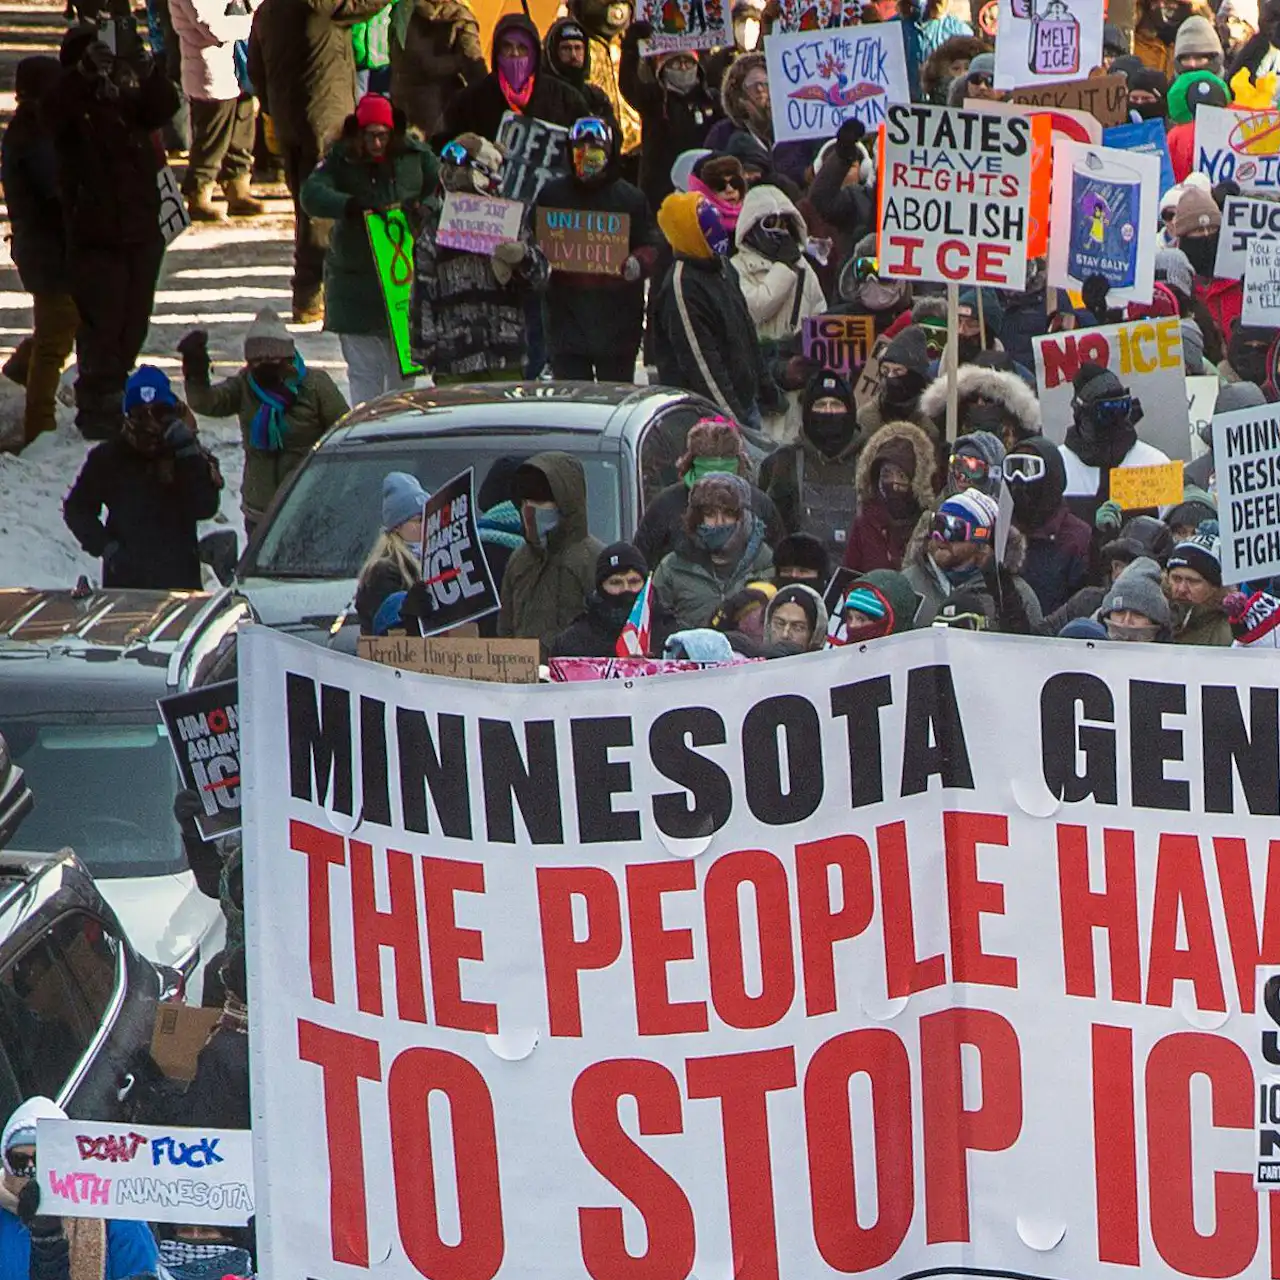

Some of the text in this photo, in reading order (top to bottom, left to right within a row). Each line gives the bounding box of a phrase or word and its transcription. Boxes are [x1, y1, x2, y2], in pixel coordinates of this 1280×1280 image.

[1041, 25, 1076, 49] MELT
[781, 40, 825, 85] GET
[831, 35, 853, 60] THE
[854, 36, 889, 86] FUCK
[1041, 47, 1076, 70] ICE!
[787, 95, 889, 131] OUT MN
[887, 105, 1030, 156] STATES
[892, 162, 1020, 199] RIGHTS
[910, 149, 1004, 174] HAVE
[1199, 146, 1237, 185] NO
[882, 197, 1025, 242] ABOLISH
[888, 236, 1012, 285] ICE
[1075, 253, 1130, 272] STAY SALTY
[808, 319, 867, 339] ICE
[1041, 318, 1182, 390] NO ICE
[363, 640, 535, 668] Terrible happening
[286, 663, 974, 847] MINNESOTA
[288, 818, 499, 1036] THE
[534, 810, 1020, 1038] PEOPLE
[150, 1136, 226, 1169] FUCK
[49, 1169, 255, 1213] WITH MINNESOTA
